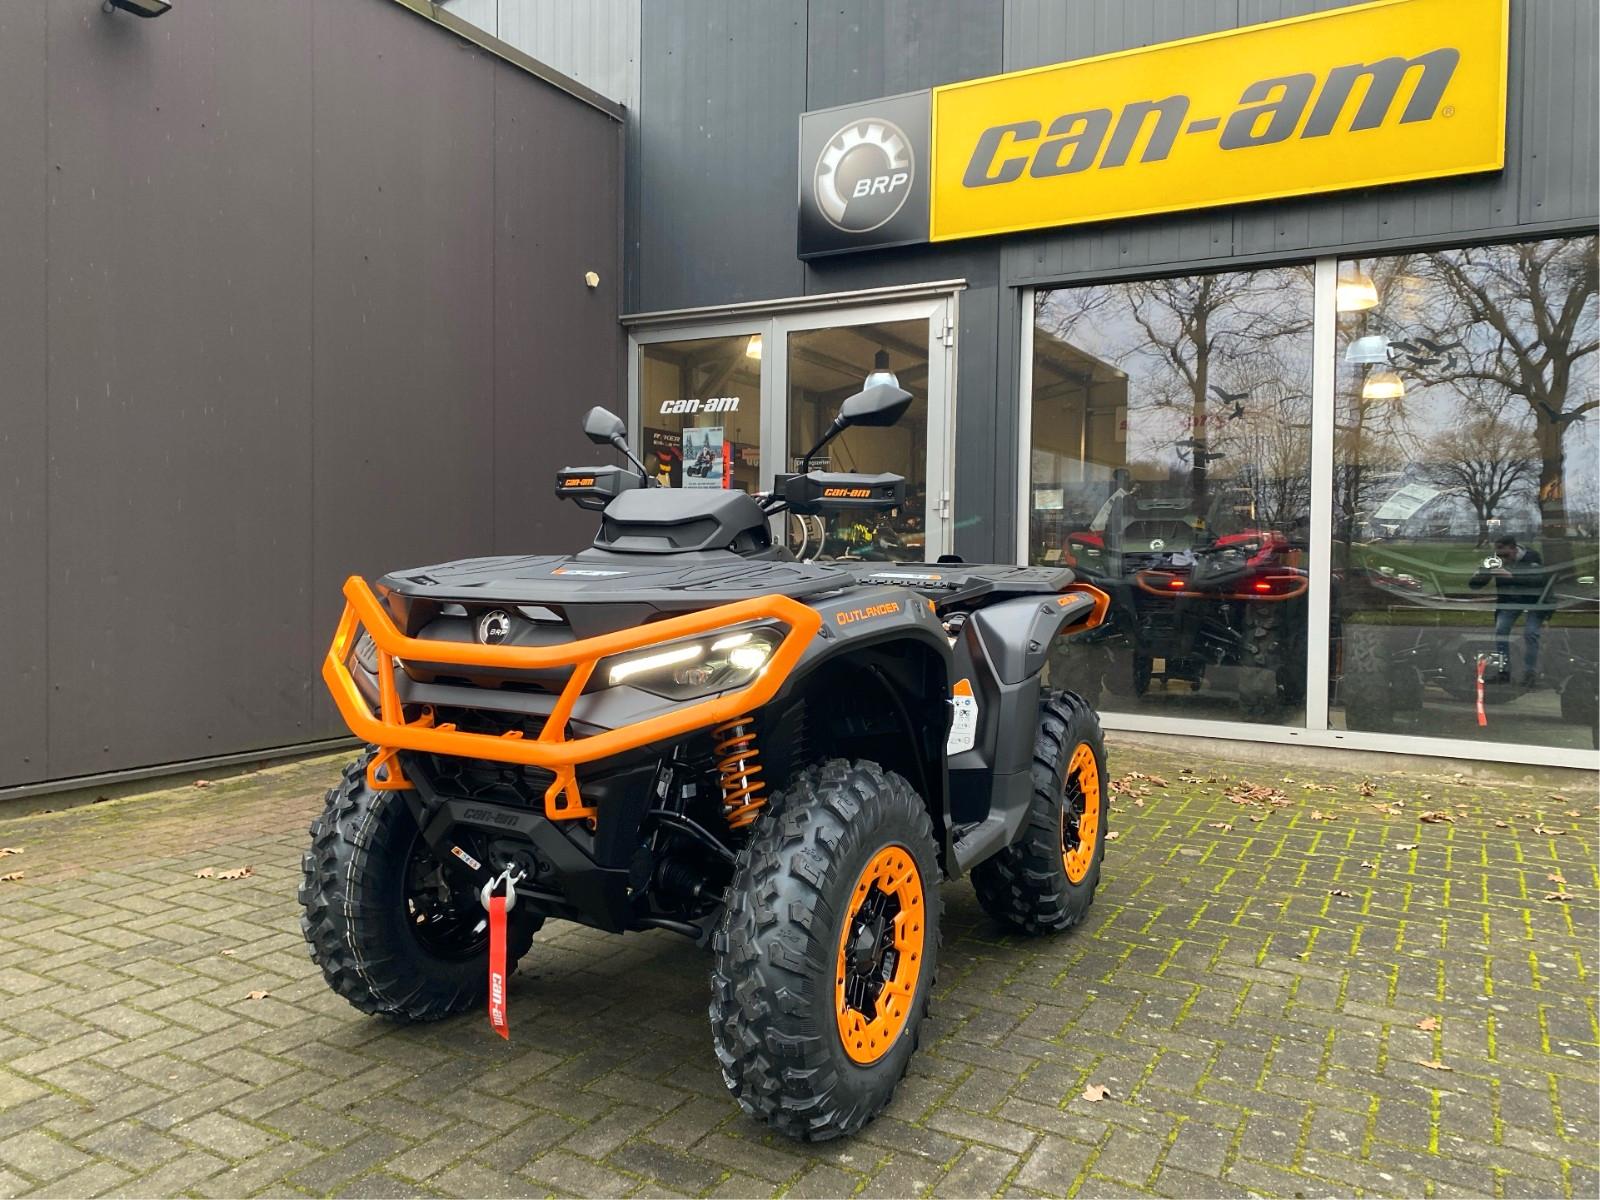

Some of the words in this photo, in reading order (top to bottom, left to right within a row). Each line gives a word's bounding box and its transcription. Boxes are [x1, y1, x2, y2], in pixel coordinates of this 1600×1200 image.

[961, 48, 1460, 189] can-am
[853, 172, 908, 198] BRP
[660, 397, 740, 414] can-am
[565, 478, 595, 486] can-am
[824, 488, 871, 498] can-am
[836, 602, 900, 625] OUTLANDER
[489, 628, 508, 636] BRP
[463, 808, 520, 827] can-am
[492, 972, 504, 1026] can-am
